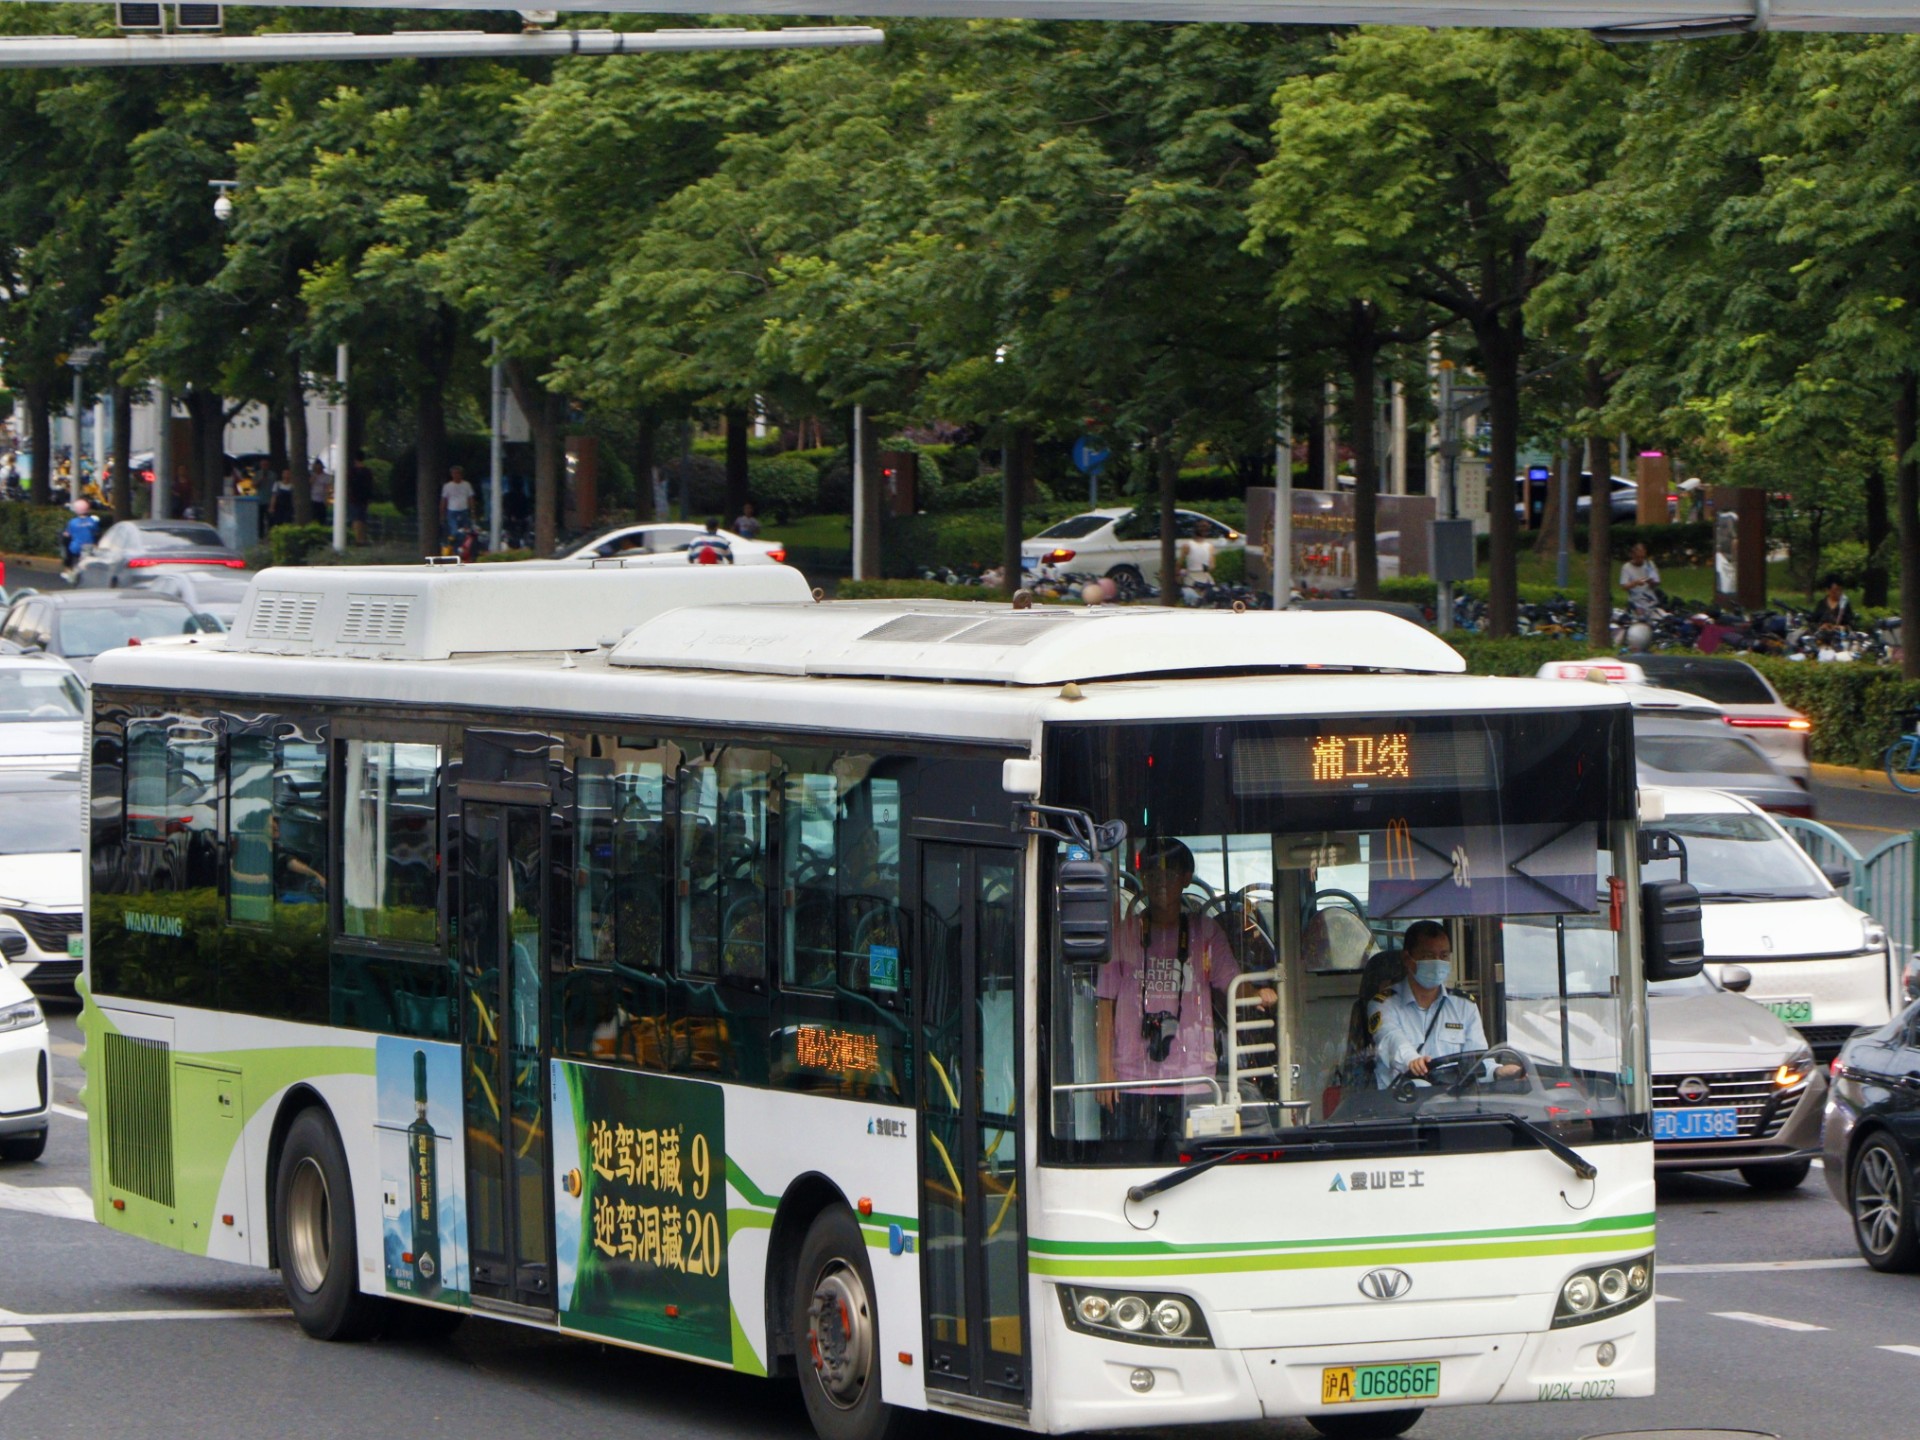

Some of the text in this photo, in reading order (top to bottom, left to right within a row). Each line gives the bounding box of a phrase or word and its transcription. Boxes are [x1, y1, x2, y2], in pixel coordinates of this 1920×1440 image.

[1312, 733, 1409, 780] 浦卫线
[125, 911, 182, 937] WANXIANG
[1149, 957, 1172, 969] THE
[591, 1119, 710, 1200] 迎驾洞藏 9
[1538, 1378, 1616, 1401] W2K-0073
